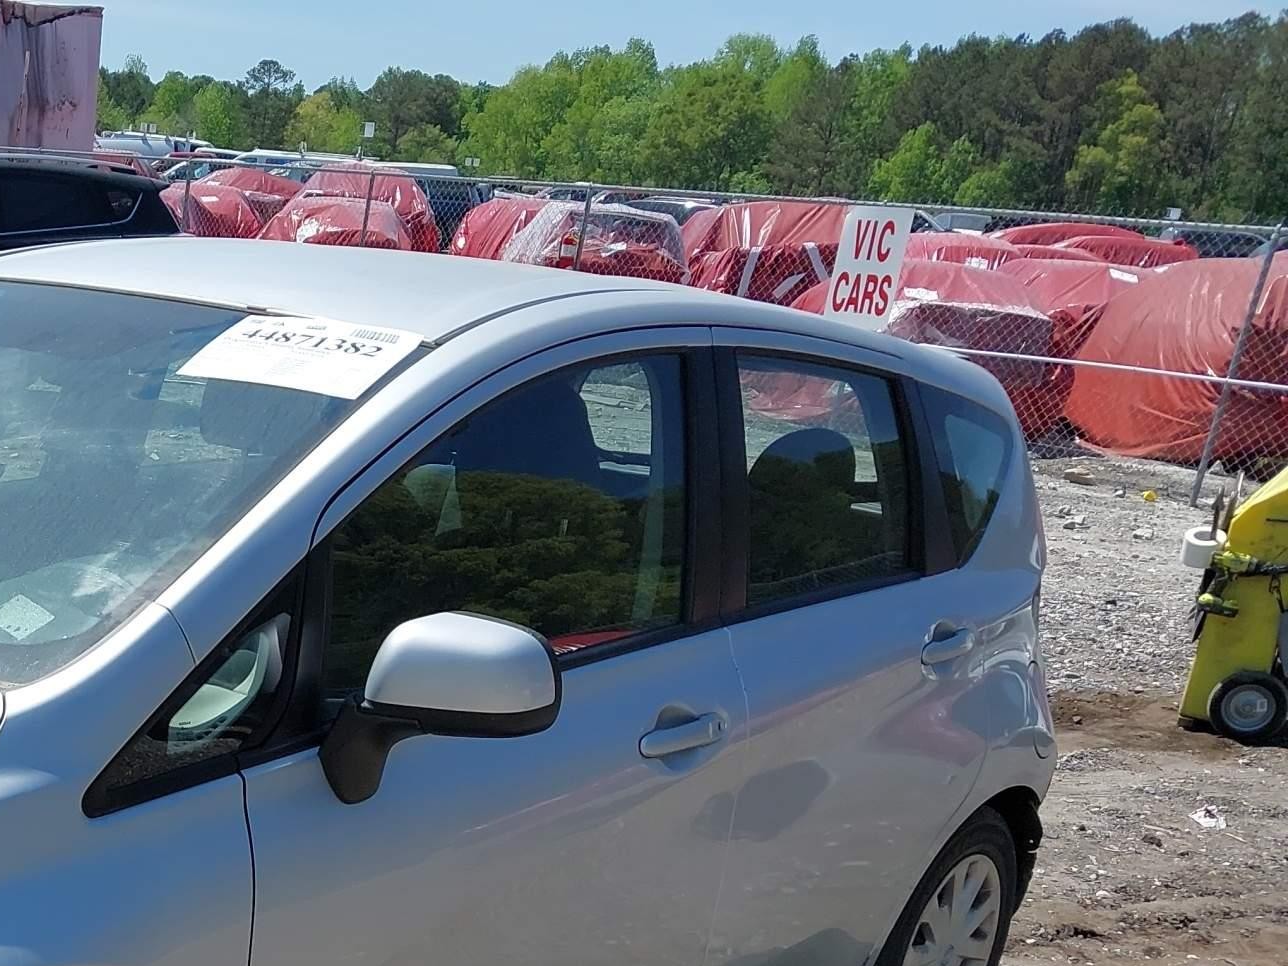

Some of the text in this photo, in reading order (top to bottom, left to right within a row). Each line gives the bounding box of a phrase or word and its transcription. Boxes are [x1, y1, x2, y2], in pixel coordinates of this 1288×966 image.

[854, 219, 896, 262] VIC
[832, 271, 893, 317] CARS
[241, 327, 385, 358] 44871382
